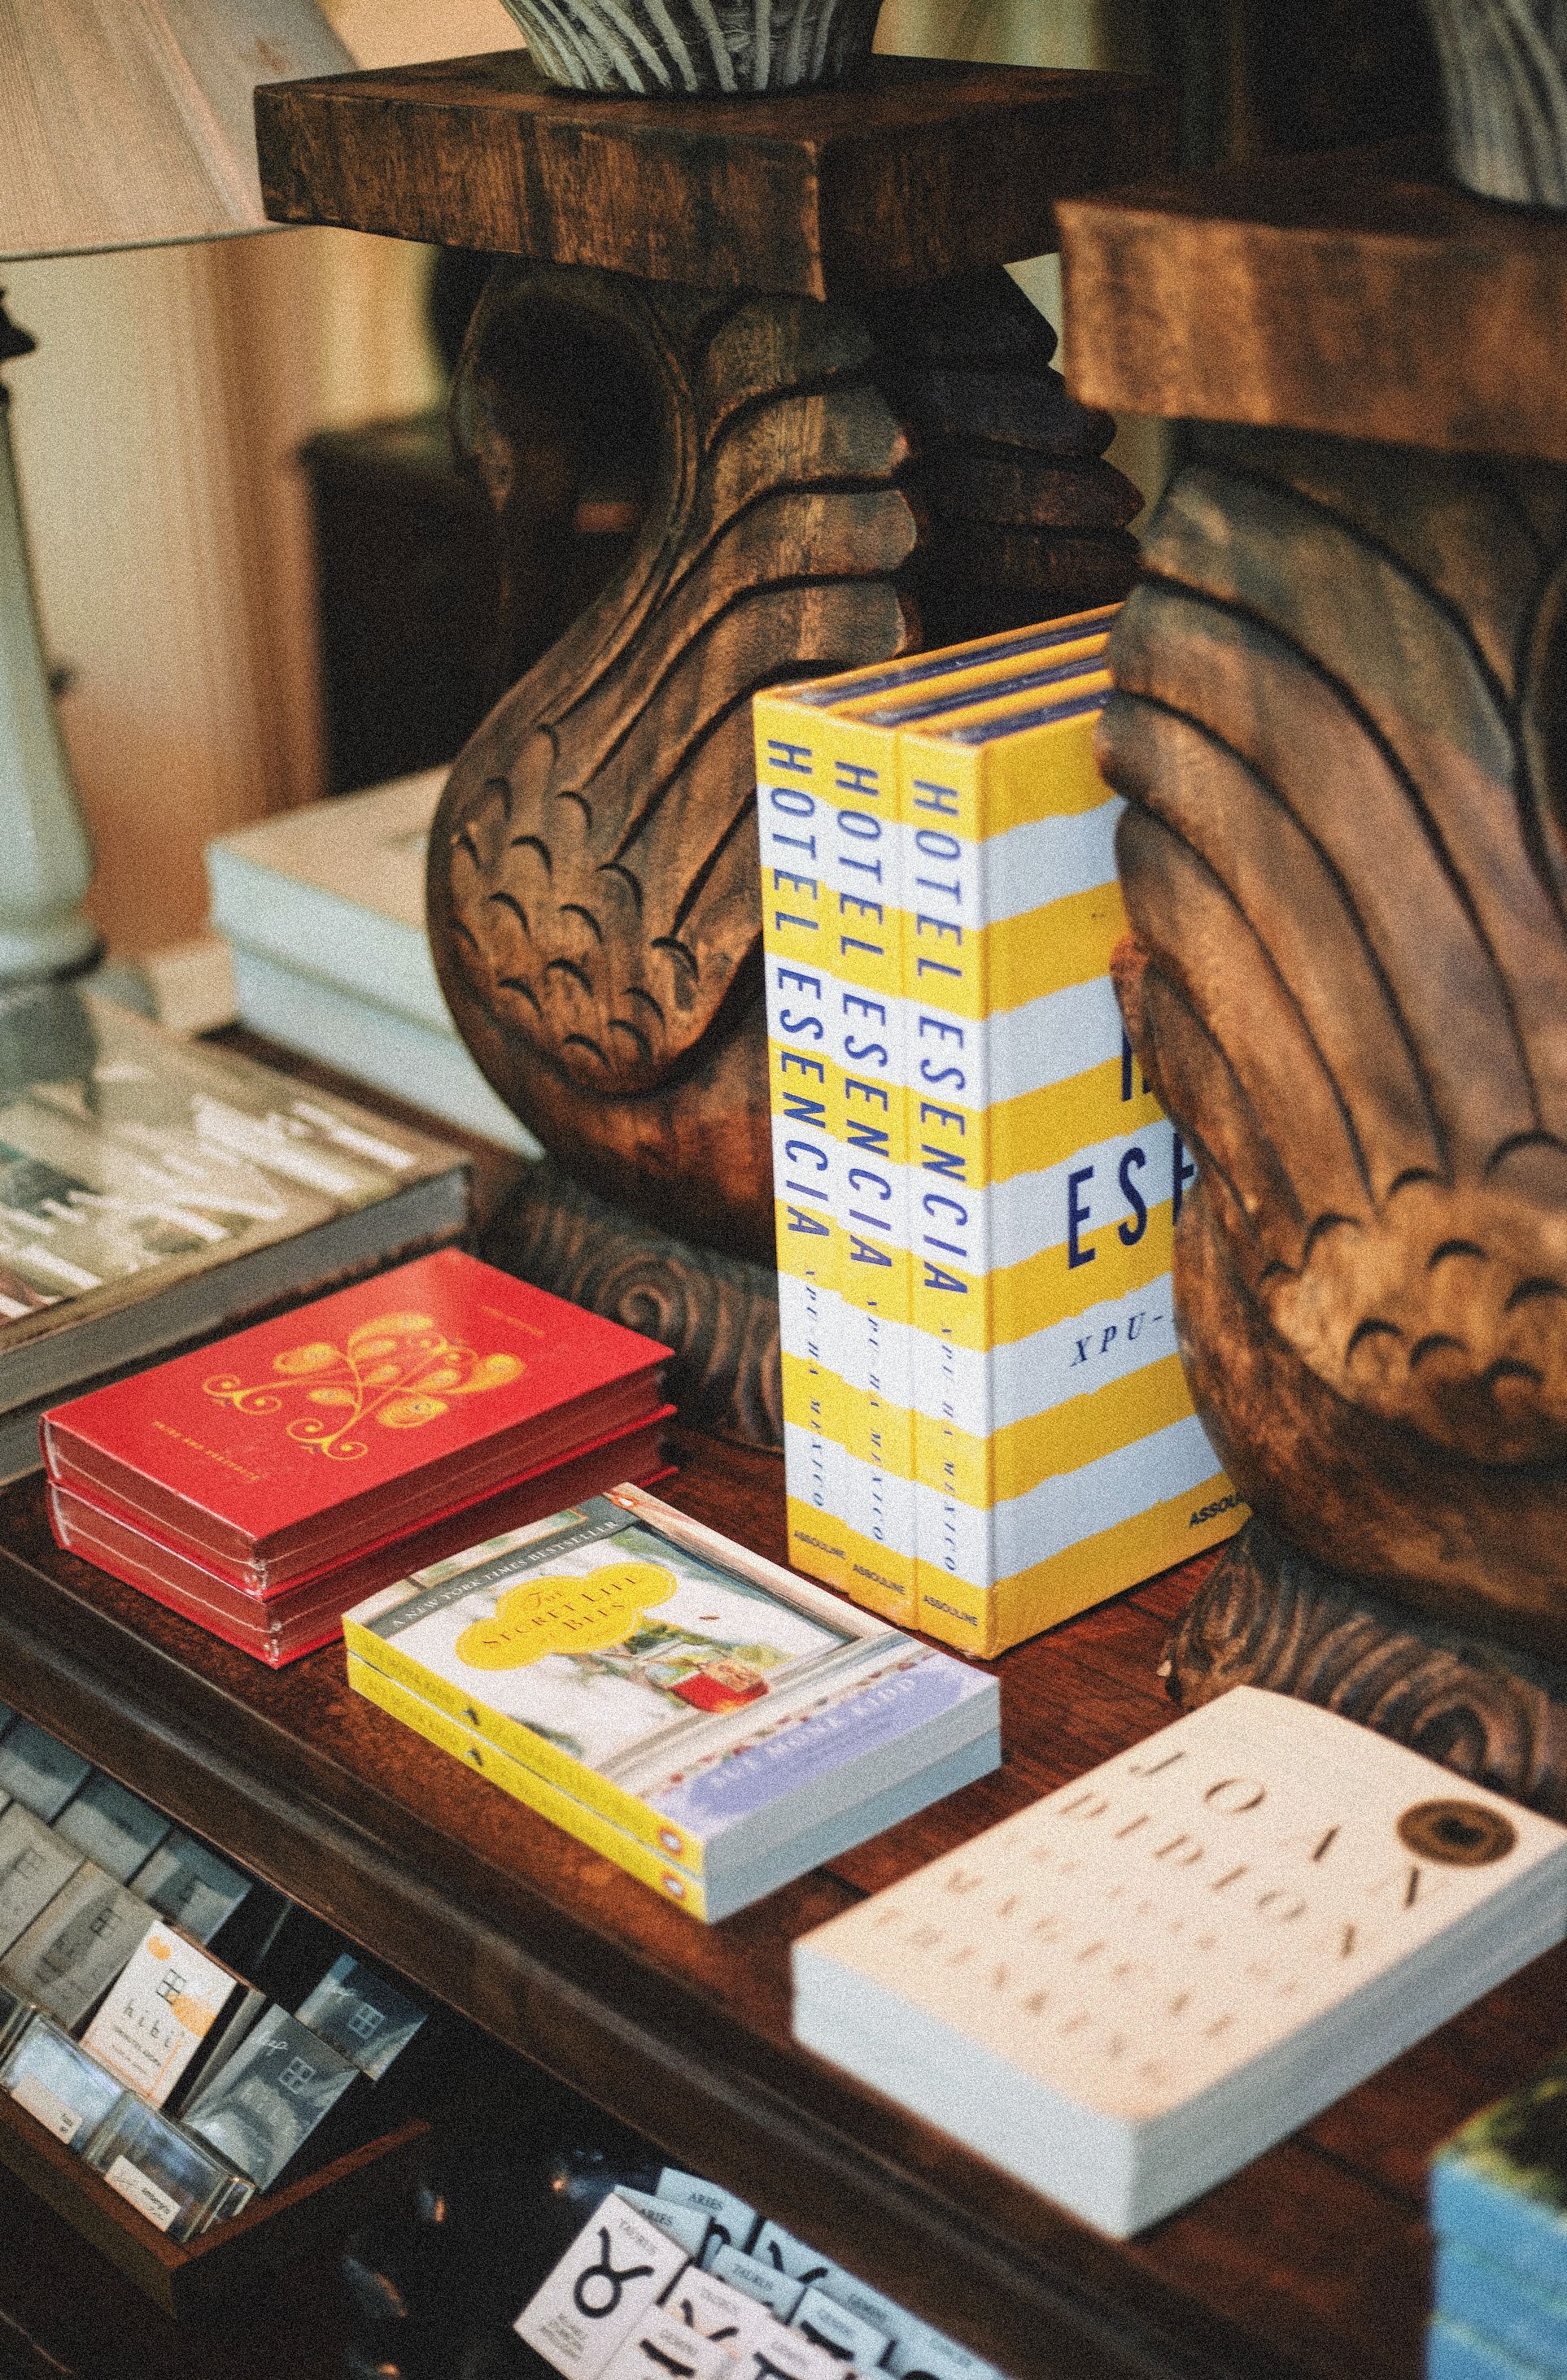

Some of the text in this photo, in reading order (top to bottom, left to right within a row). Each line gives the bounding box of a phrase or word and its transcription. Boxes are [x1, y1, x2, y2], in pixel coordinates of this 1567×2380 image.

[767, 739, 830, 1236] HOTEL ESENCIA
[835, 761, 893, 1267] HOTEL ESENCIA
[913, 780, 968, 1294] HOTEL ESENCIA
[406, 1600, 438, 1619] NEW
[443, 1577, 482, 1600] YORK
[483, 1558, 527, 1581] TIMES
[528, 1520, 618, 1563] BESTSELLER
[482, 1602, 576, 1647] SECRET
[581, 1576, 639, 1603] LIFE
[562, 1602, 626, 1632] BEES
[849, 1677, 918, 1718] KIDD
[1057, 1789, 1377, 1960] DIDION
[1128, 1750, 1444, 1910] JOAN
